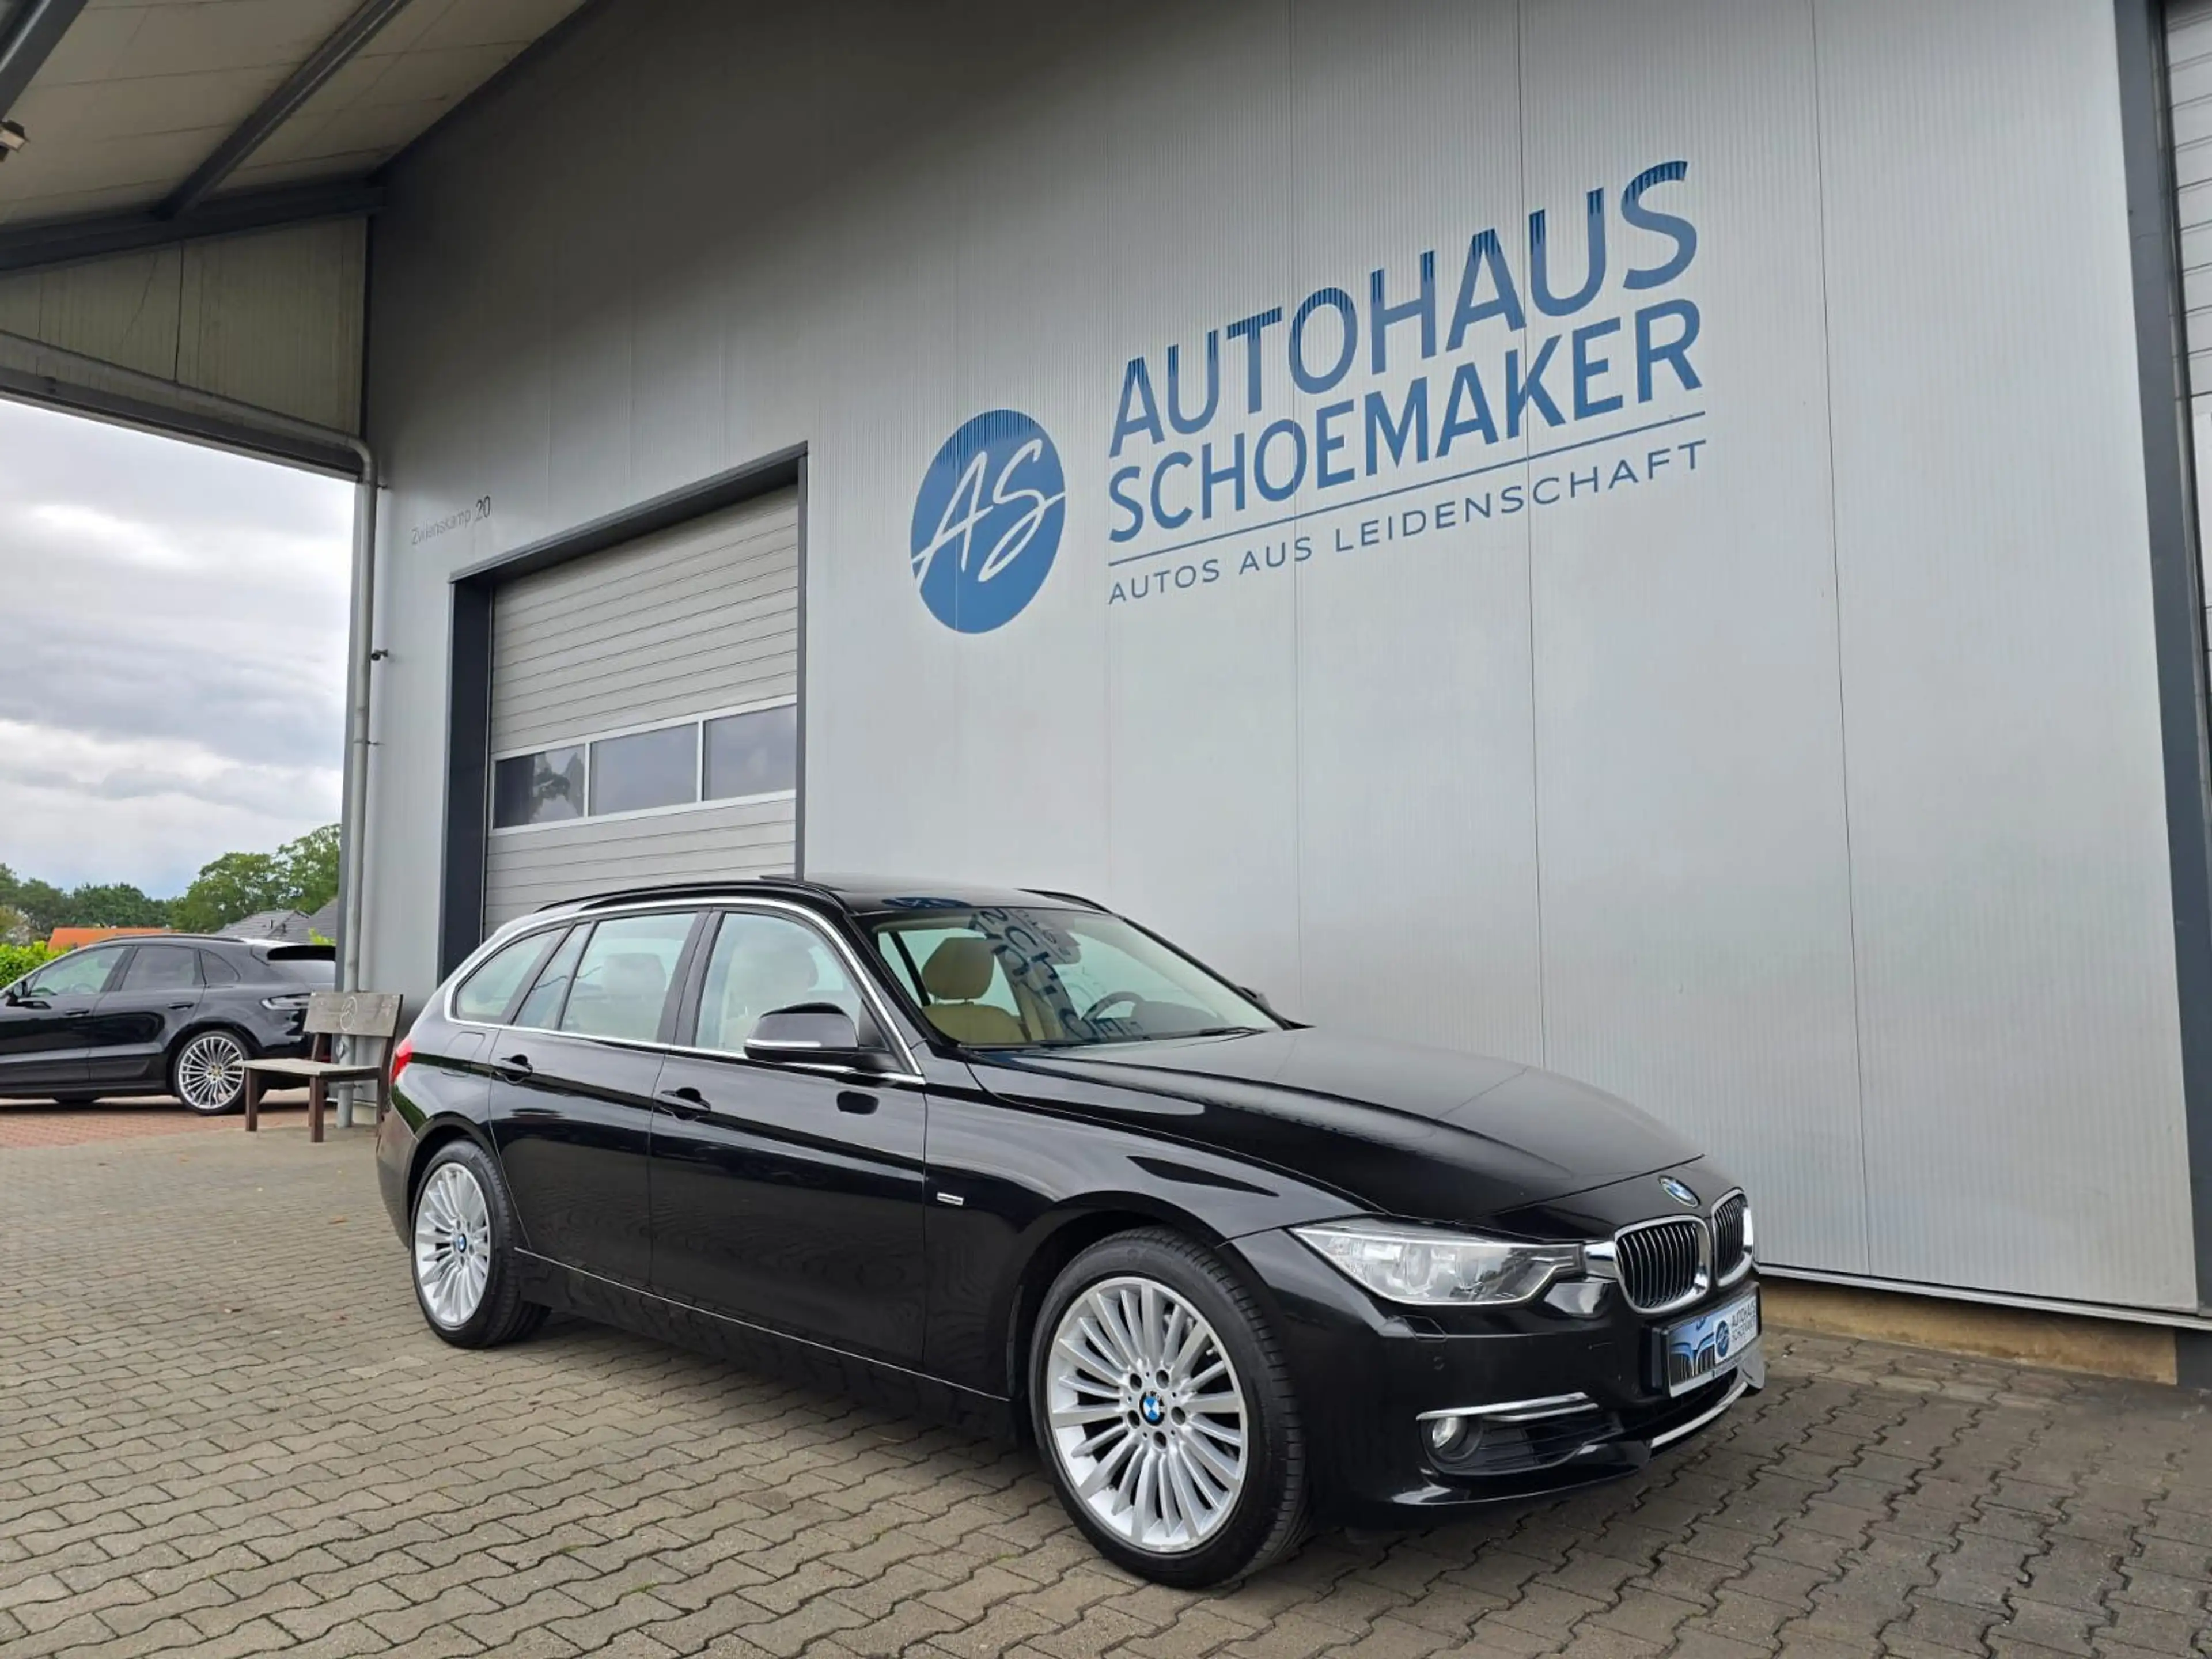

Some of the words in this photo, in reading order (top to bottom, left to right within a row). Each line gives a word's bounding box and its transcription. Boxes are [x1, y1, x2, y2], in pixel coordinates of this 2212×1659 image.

[1108, 157, 1699, 459] AUTOHAUS
[1108, 298, 1703, 543] SCHOEMAKER
[475, 495, 491, 522] 20
[911, 438, 1065, 592] AS
[1108, 559, 1220, 605] AUTOS
[1238, 536, 1312, 575] AUS
[1335, 439, 1707, 552] LEIDENSCHAFT
